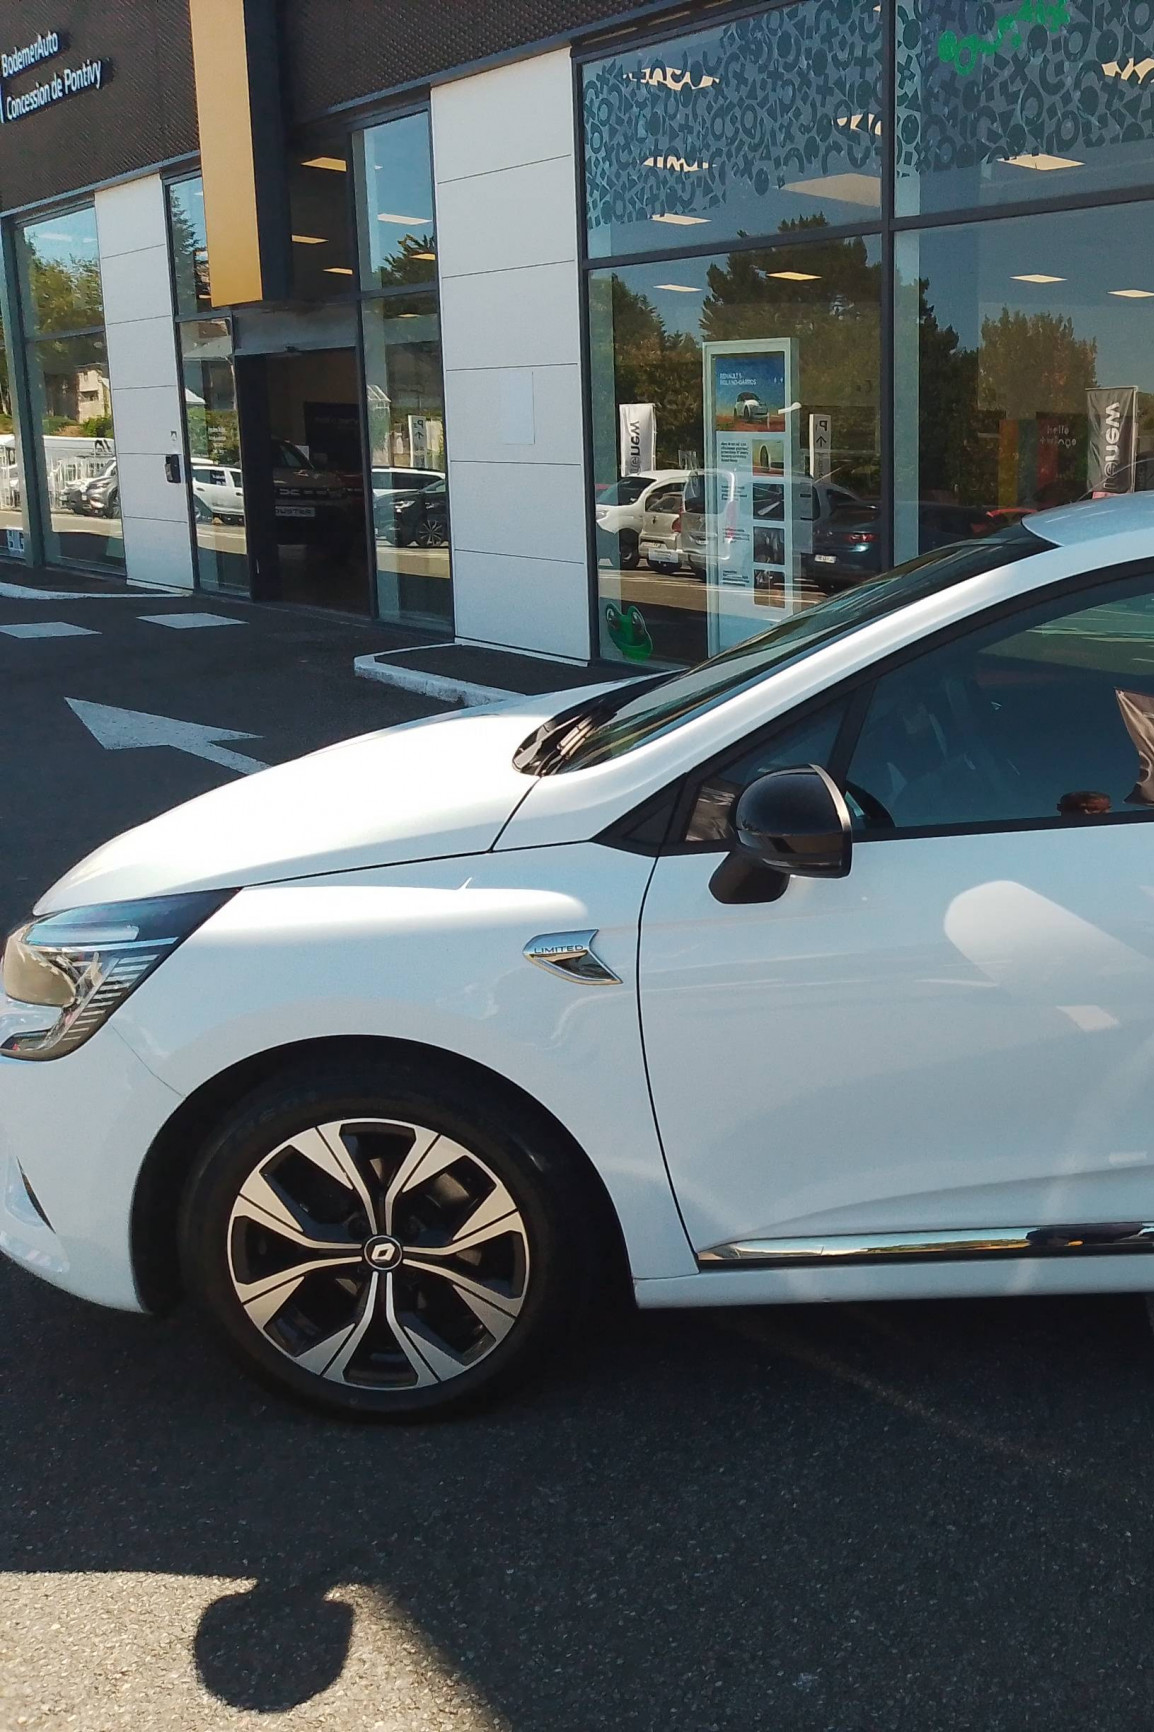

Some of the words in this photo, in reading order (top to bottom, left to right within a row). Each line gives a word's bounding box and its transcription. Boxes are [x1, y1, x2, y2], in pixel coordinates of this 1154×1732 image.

[1, 31, 58, 77] BodemerAuto
[6, 83, 51, 120] Concession
[51, 73, 63, 101] de
[64, 59, 101, 93] Pontivy
[534, 944, 584, 954] LIMITED
